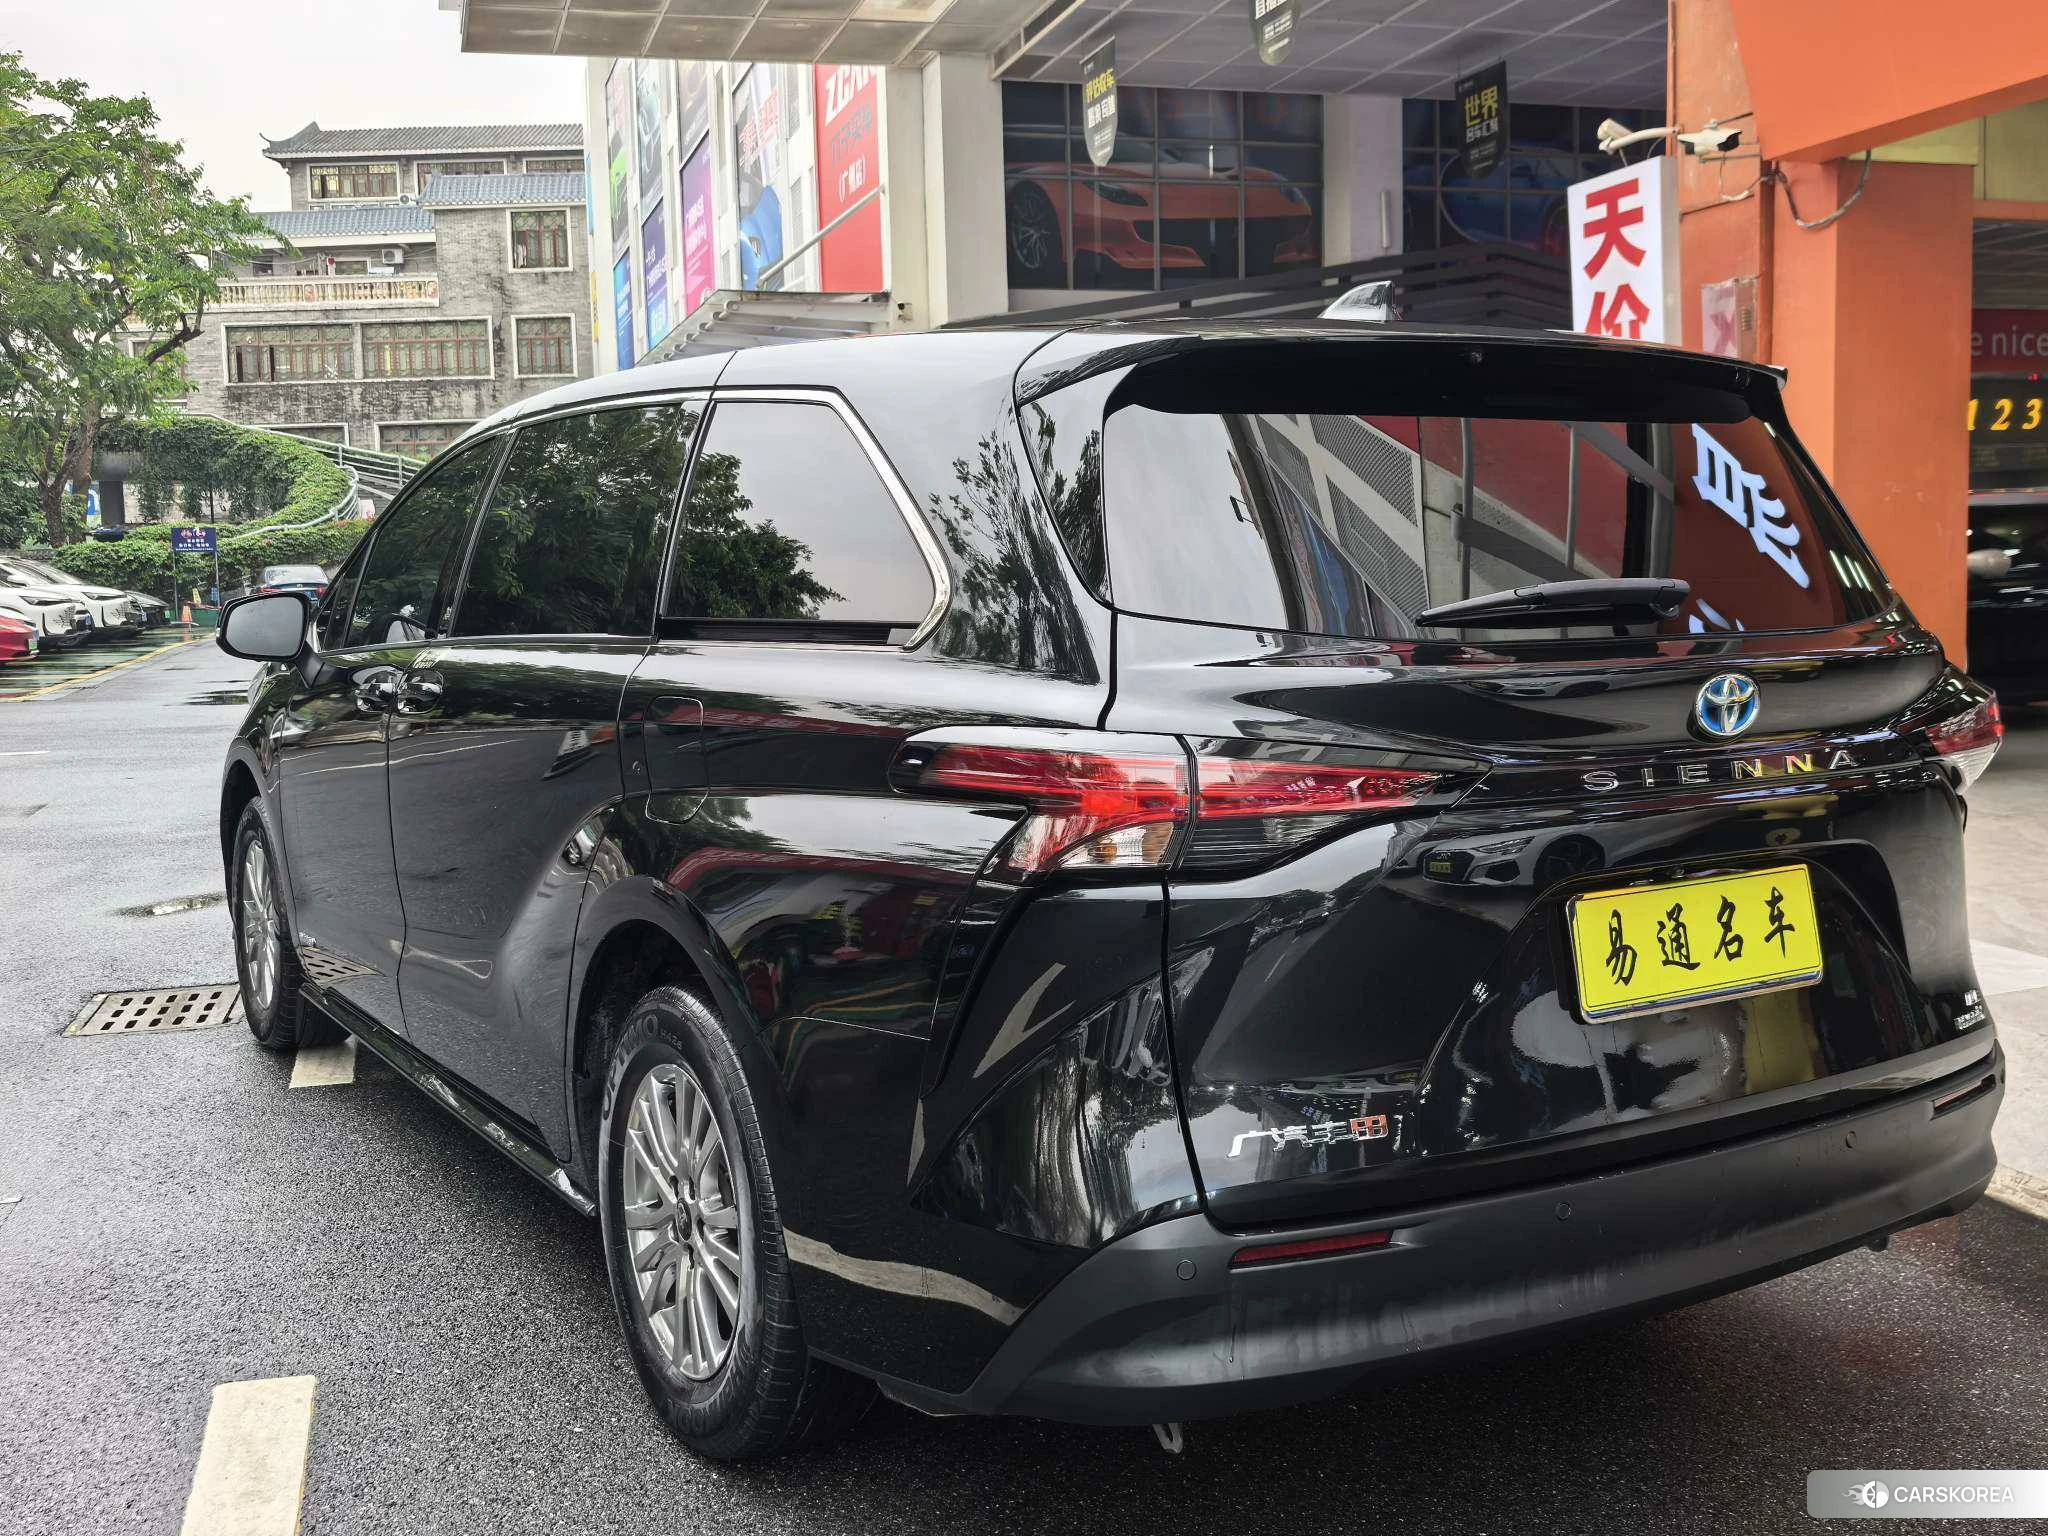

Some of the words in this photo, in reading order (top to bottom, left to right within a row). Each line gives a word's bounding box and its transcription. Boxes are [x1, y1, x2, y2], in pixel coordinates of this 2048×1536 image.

[1465, 85, 1498, 127] 世界
[1992, 327, 2048, 357] nice
[1583, 749, 1859, 791] SIENNA
[1605, 886, 1796, 986] 易通名车
